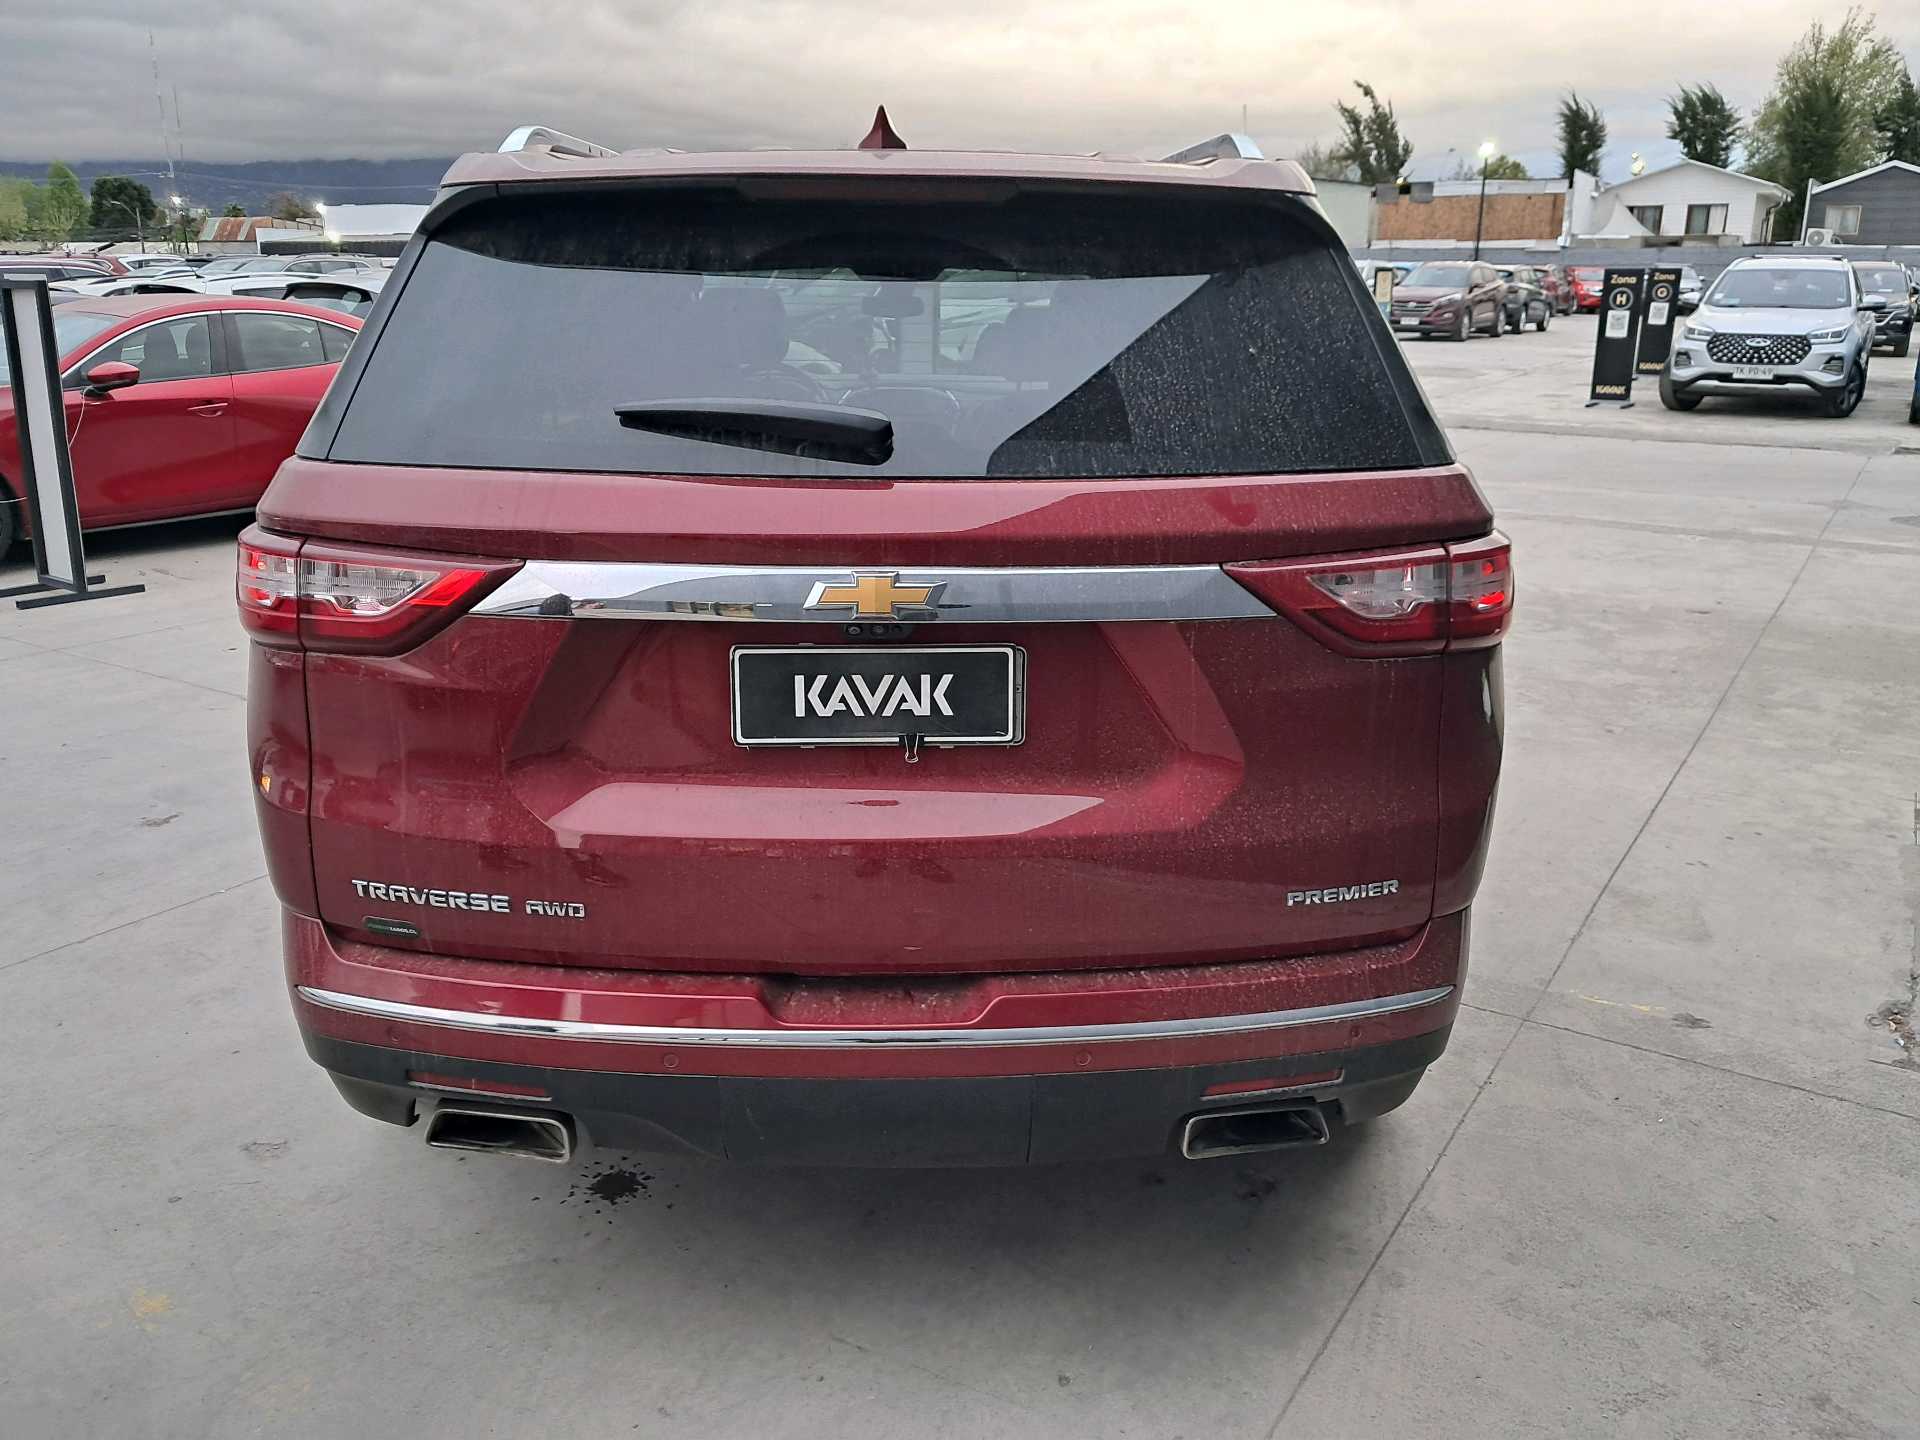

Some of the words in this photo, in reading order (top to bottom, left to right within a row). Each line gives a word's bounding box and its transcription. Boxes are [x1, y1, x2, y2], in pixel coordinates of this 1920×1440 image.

[1610, 274, 1637, 284] Zona
[1653, 272, 1675, 281] Zona
[1615, 293, 1628, 306] H
[1595, 384, 1626, 395] KAVAK
[795, 674, 954, 717] KAVAK
[351, 879, 511, 913] TRAVERSE
[525, 900, 586, 918] AWD
[1287, 879, 1400, 906] PREMIER
